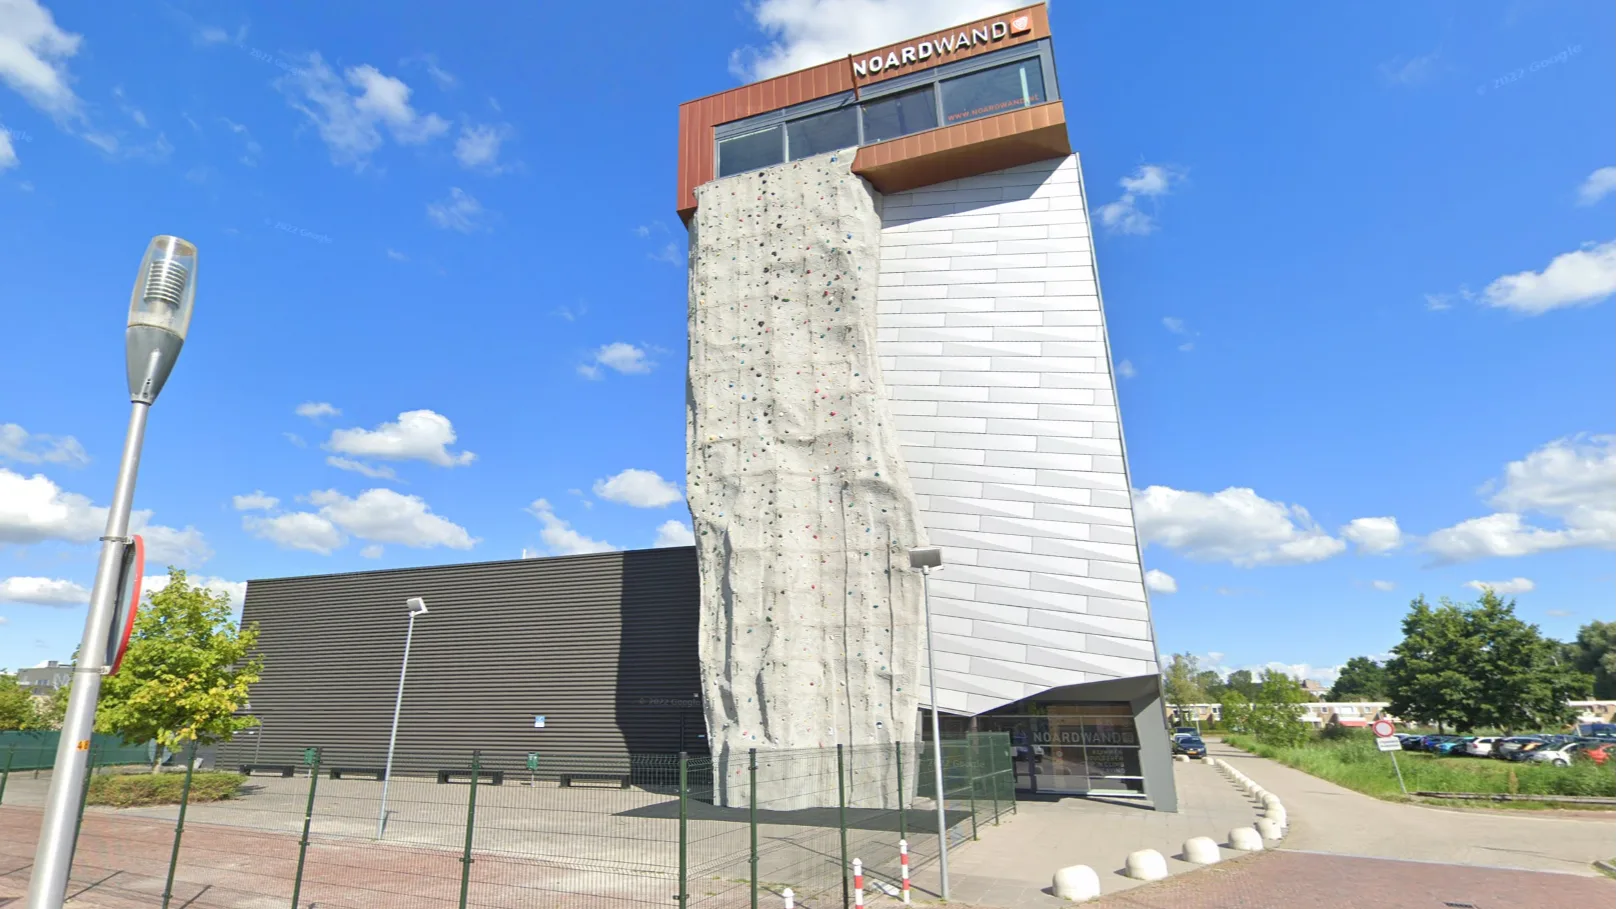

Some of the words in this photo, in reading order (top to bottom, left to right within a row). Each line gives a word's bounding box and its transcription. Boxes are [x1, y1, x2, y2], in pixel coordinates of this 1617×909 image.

[853, 20, 1007, 76] NOARDWAND
[947, 93, 1040, 122] WWW.NOARDWANDNL
[1033, 732, 1121, 744] NOARDWAND
